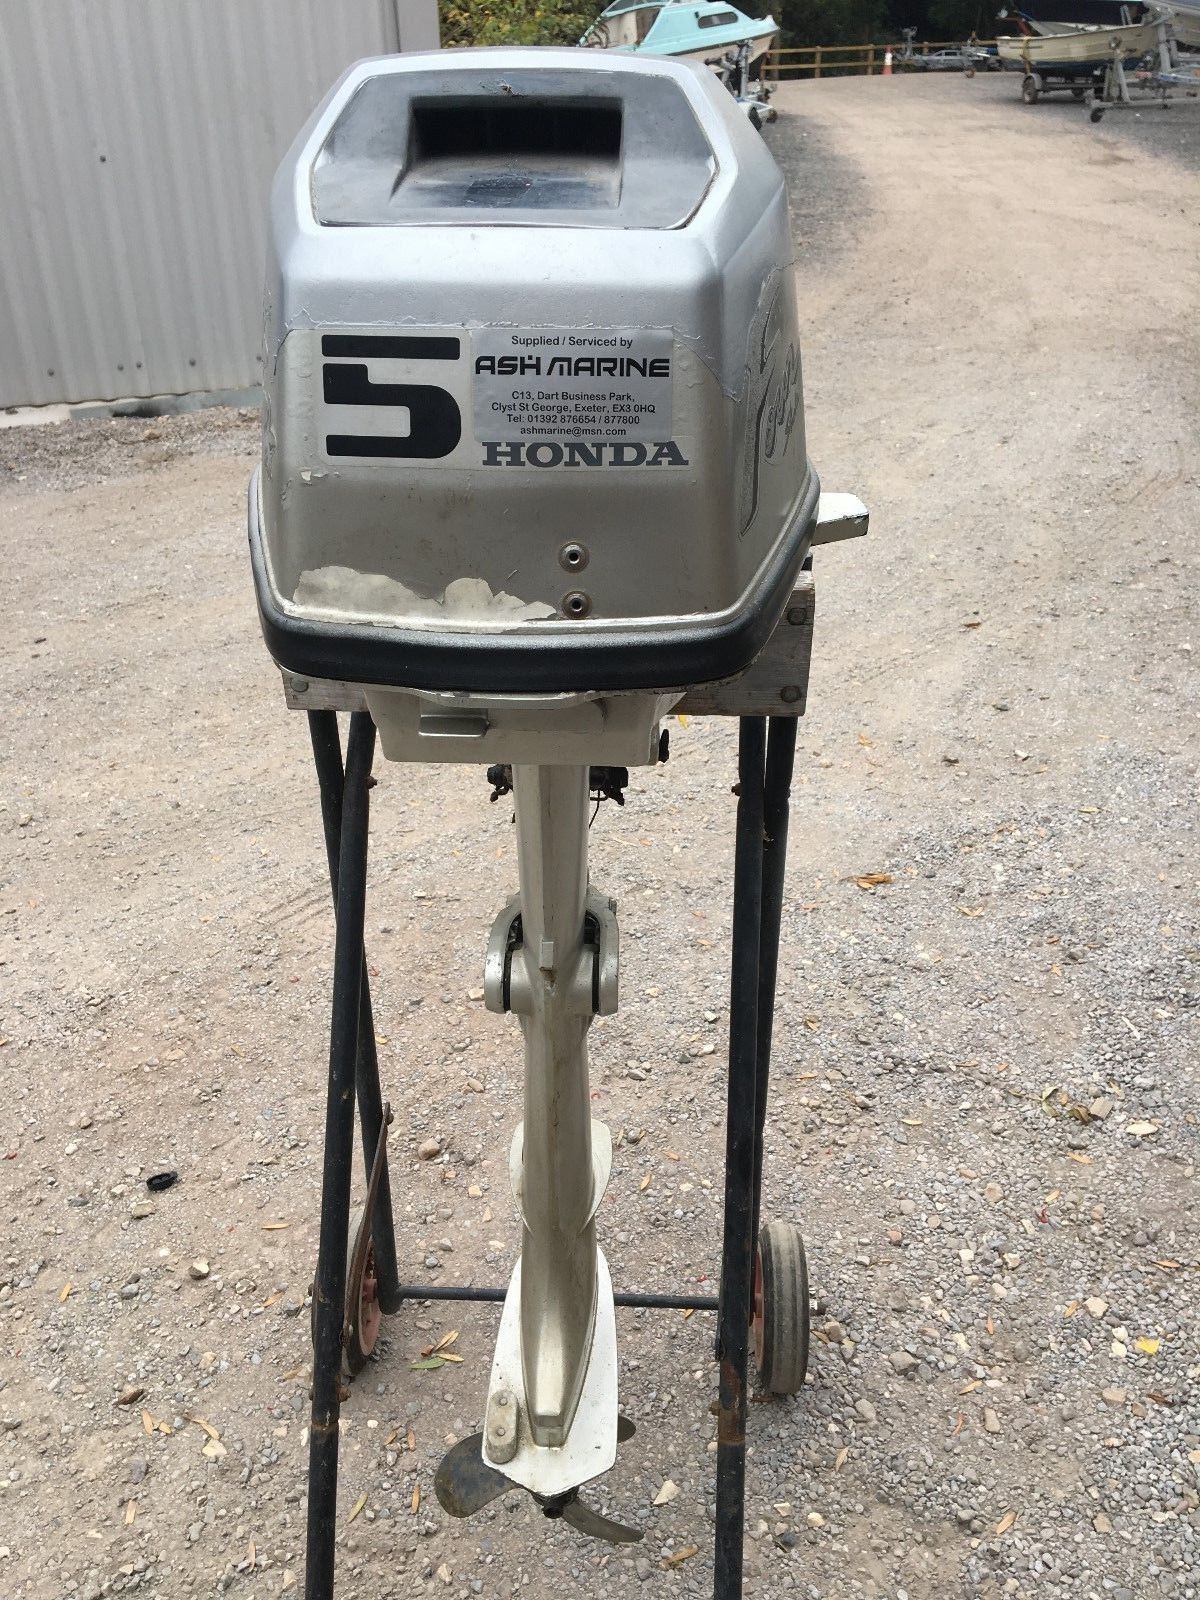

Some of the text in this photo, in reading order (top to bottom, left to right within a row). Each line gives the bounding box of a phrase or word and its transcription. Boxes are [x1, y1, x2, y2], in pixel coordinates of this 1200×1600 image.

[511, 335, 560, 347] Supplied
[568, 336, 617, 346] Serviced
[620, 337, 633, 349] by
[475, 355, 670, 377] ASH MARINE
[322, 335, 462, 459] 5
[511, 390, 635, 402] C13, Dart Business Park,
[491, 402, 517, 413] Clyst
[519, 403, 530, 411] St
[532, 403, 572, 413] George,
[574, 403, 610, 413] Exeter,
[612, 404, 632, 413] EX3
[507, 413, 525, 423] Tel:
[527, 414, 558, 423] 01392
[560, 415, 596, 424] 876654
[604, 416, 640, 425] 877800
[520, 426, 627, 437] ashmarine@msn.com
[482, 441, 689, 468] HONDA
